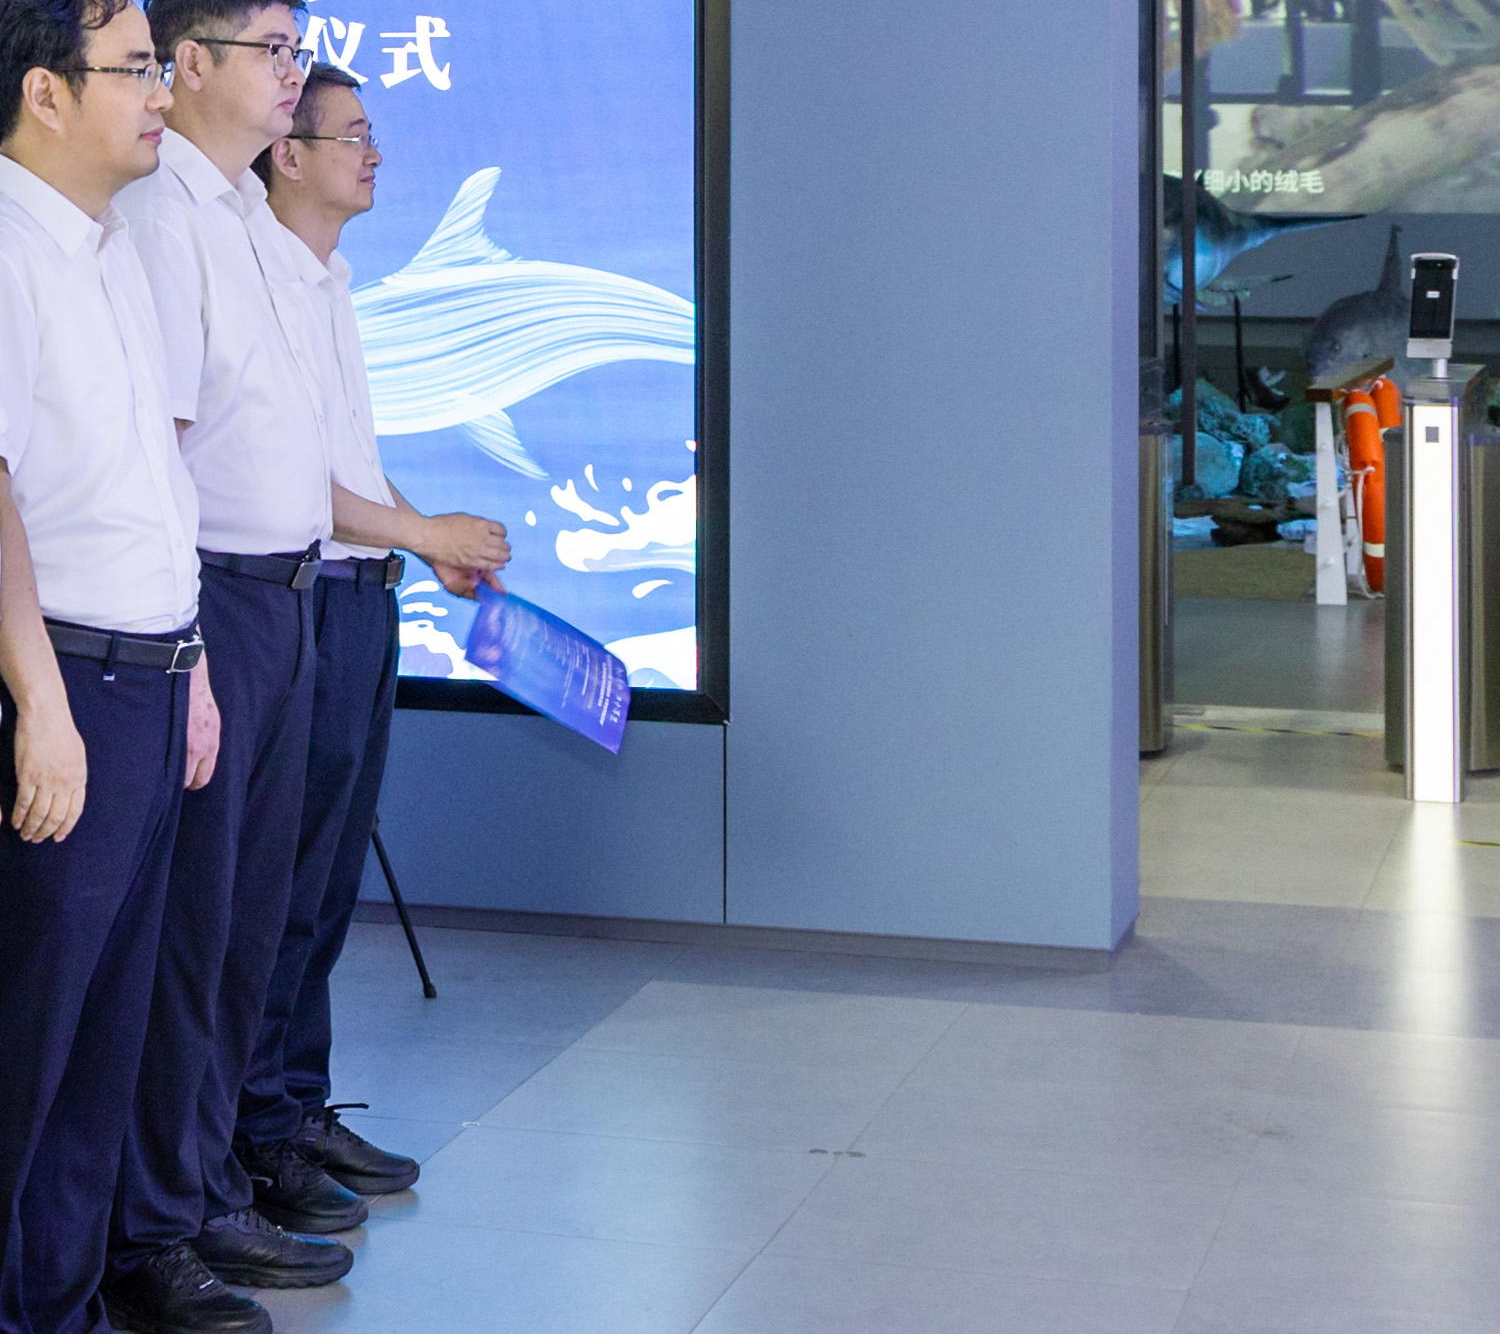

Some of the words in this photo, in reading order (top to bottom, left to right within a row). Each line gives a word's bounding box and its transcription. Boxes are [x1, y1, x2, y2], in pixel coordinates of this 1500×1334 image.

[1193, 168, 1325, 195] 细小的绒毛
